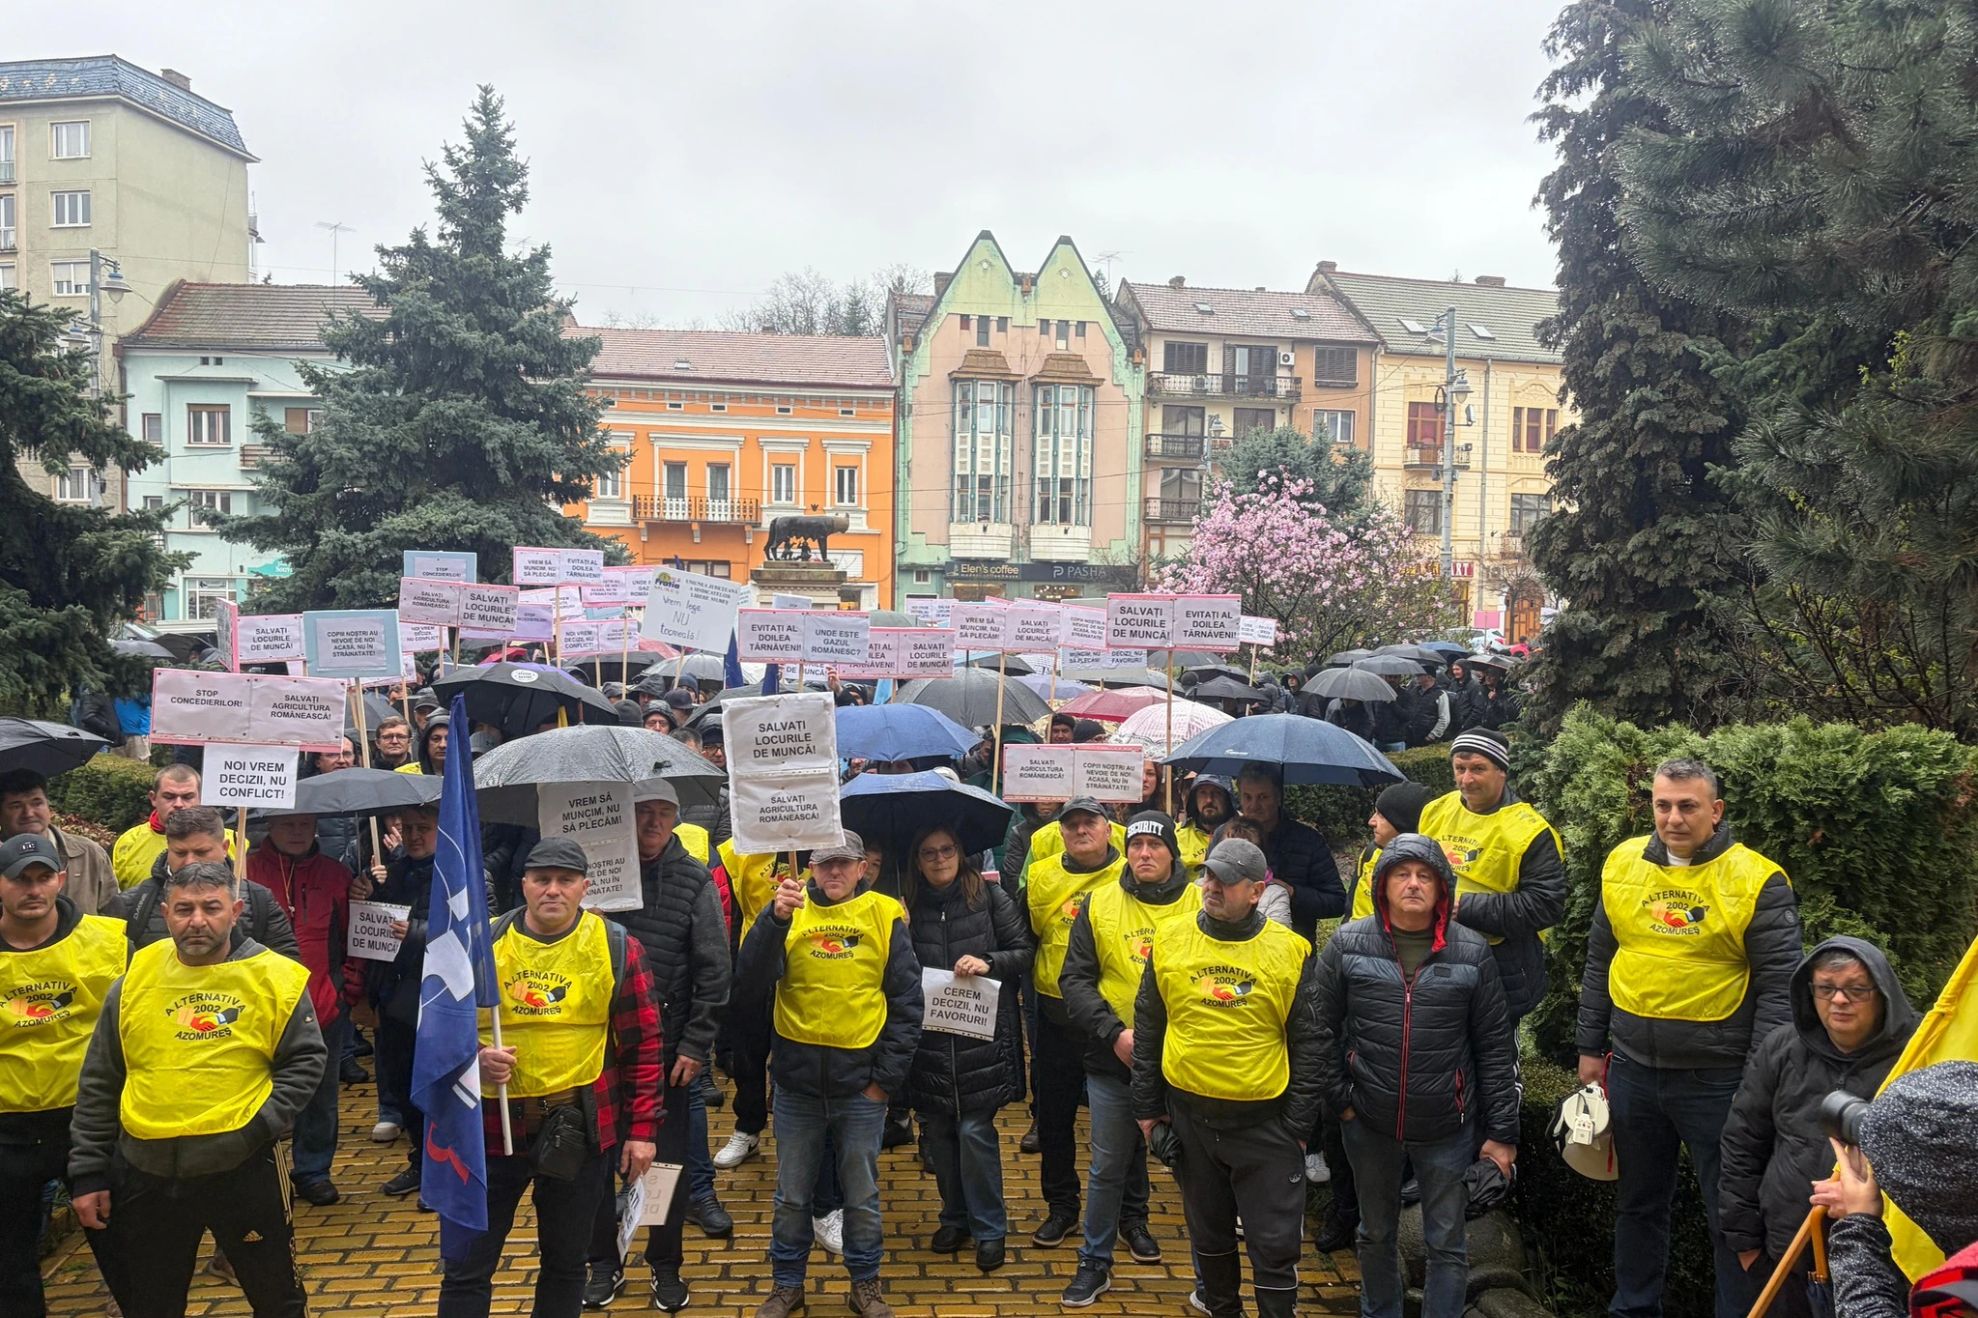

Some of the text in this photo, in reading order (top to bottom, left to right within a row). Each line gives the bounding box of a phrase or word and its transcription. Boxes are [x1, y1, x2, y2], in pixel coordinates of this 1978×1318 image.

[961, 564, 1018, 574] Elen's coffee
[1068, 566, 1106, 577] PASHA
[470, 593, 508, 604] SALVAȚI
[466, 603, 510, 614] LOCURILE
[1120, 607, 1163, 618] SALVAȚI
[463, 613, 476, 621] DE
[478, 613, 514, 624] MUNCĂ!
[673, 611, 689, 625] NU
[1186, 610, 1233, 620] EVITAȚI AL
[960, 624, 988, 632] MUNCIM,
[1021, 619, 1048, 627] SALVAȚI
[1115, 618, 1166, 628] LOCURILE
[1193, 620, 1225, 629] DOILEA
[752, 625, 784, 633] EVITAȚI
[815, 630, 859, 639] UNDE ESTE
[1113, 628, 1170, 640] DE MUNCĂ!
[1184, 629, 1236, 639] TÂRNĂVENI!
[759, 634, 790, 642] DOILEA
[749, 643, 801, 651] TÂRNĂVENI!
[811, 646, 860, 655] ROMÂNESC?
[913, 643, 944, 651] SALVAȚI
[171, 697, 242, 707] CONCEDIERILOR!
[285, 695, 319, 703] SALVAȚI
[272, 703, 330, 711] AGRICULTURA
[271, 711, 331, 720] ROMÂNEASCĂ!
[759, 720, 806, 733] SALVAȚI
[755, 733, 812, 746] LOCURILE
[754, 745, 816, 758] DE MUNCĂ!
[224, 761, 284, 772] NOI VREM
[220, 775, 286, 785] DECIZII, NU
[220, 787, 284, 799] CONFLICT!
[569, 792, 613, 808] VREM SĂ
[771, 795, 805, 804] SALVAȚI
[562, 804, 620, 821] MUNCIM, NU
[760, 804, 818, 814] AGRICULTURA
[759, 813, 819, 823] ROMÂNEASCĂ!
[563, 816, 622, 833] SĂ PLECĂM!
[1128, 821, 1165, 837] SECURITY
[1642, 890, 1710, 912] ALTERNATIVA
[1666, 901, 1689, 910] 2002
[802, 925, 864, 940] ALTERNATIVA
[1650, 923, 1700, 935] AZOMUREȘ
[353, 938, 399, 953] DE MUNCĂ!
[504, 970, 572, 990] ALTERNATIVA
[1190, 965, 1257, 985] ALTERNATIVA
[527, 981, 550, 992] 2002
[1214, 977, 1237, 985] 2002
[0, 981, 77, 1008] ALTERNATIVA
[26, 993, 54, 1003] 2002
[944, 987, 981, 1000] CEREM
[165, 993, 247, 1017] ALTERNATIVA
[193, 1004, 221, 1013] 2002
[932, 997, 989, 1014] DECIZII, NU
[930, 1010, 987, 1026] FAVORURI!
